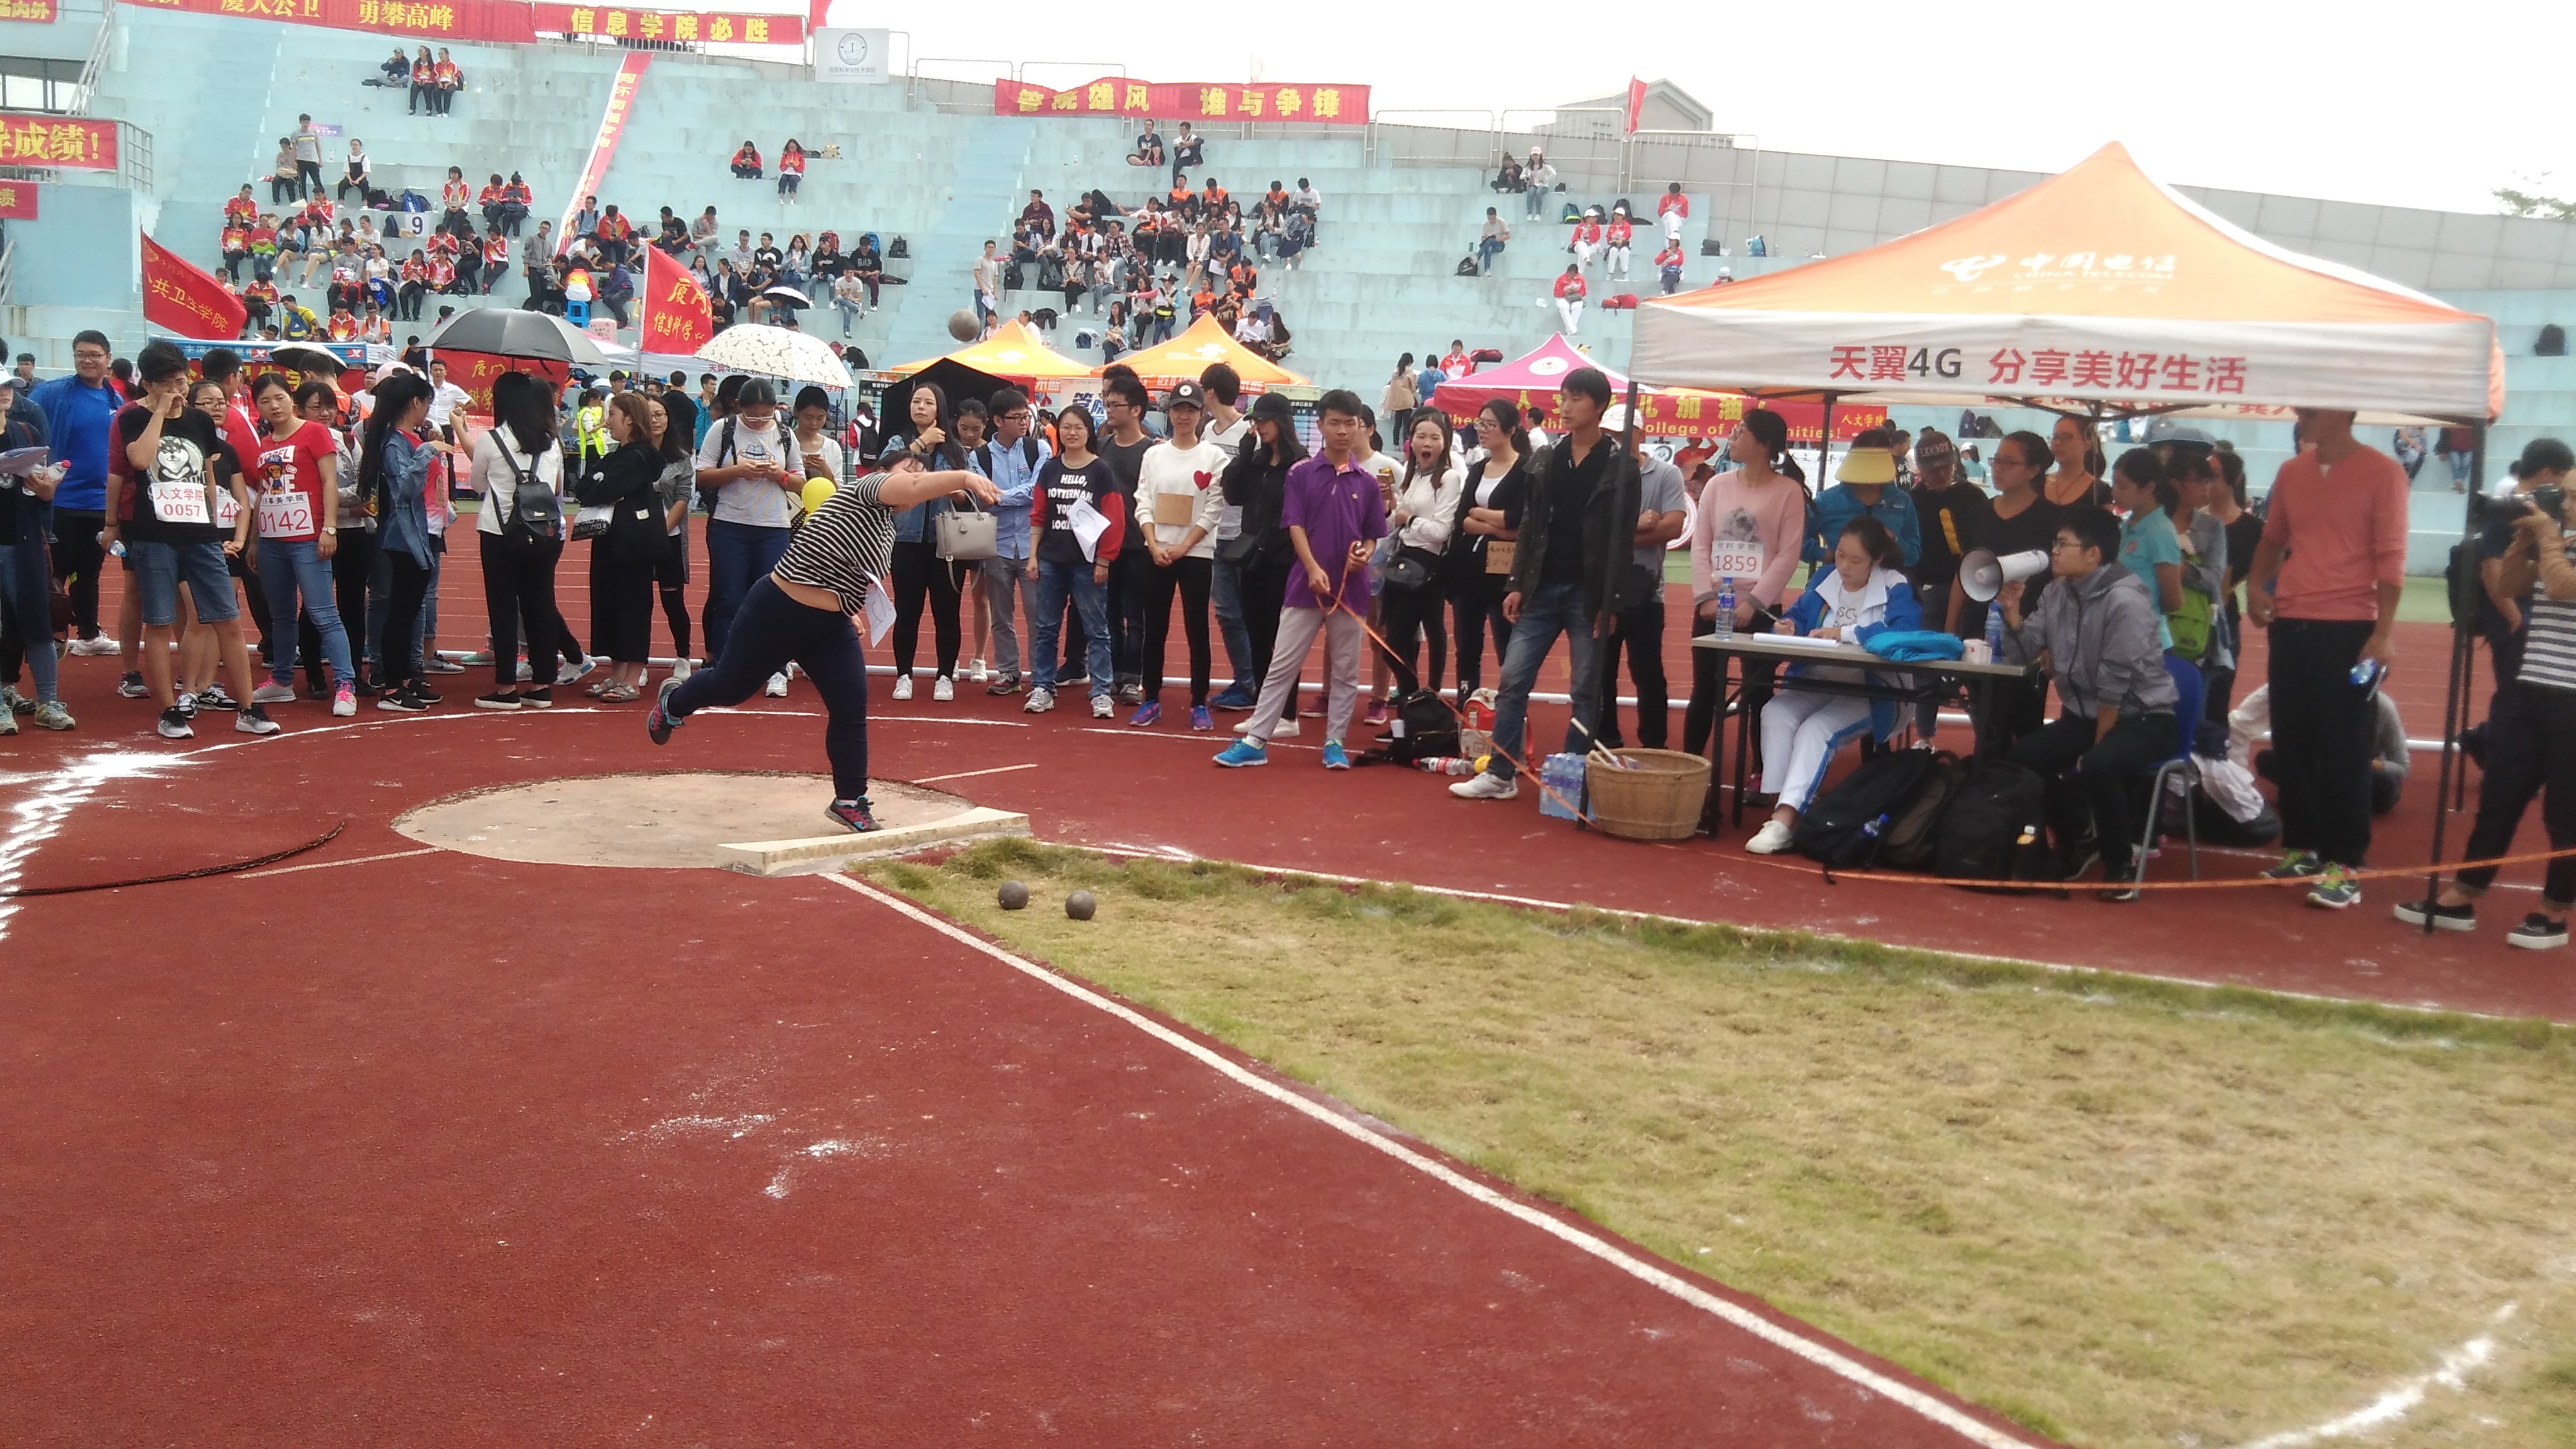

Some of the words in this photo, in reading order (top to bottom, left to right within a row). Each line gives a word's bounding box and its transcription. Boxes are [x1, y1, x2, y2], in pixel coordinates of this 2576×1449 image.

[358, 0, 454, 31] 勇攀高峰
[571, 8, 769, 43] 信息学院必胜
[1200, 87, 1340, 118] 谁与争锋
[412, 216, 423, 235] 9
[2018, 252, 2178, 272] 中国电信
[2013, 270, 2075, 280] CHINA
[2081, 270, 2174, 280] TELECOM
[147, 272, 228, 333] 共卫生学院
[1829, 345, 1962, 382] 天翼4G
[1987, 348, 2247, 394] 分享美好生活
[1643, 421, 1698, 436] ollege
[1707, 423, 1724, 435] of
[1060, 474, 1088, 487] HELLO,
[157, 487, 204, 502] 人文学院
[163, 504, 201, 517] 0057
[259, 509, 311, 533] 0142
[1715, 555, 1757, 572] 1859
